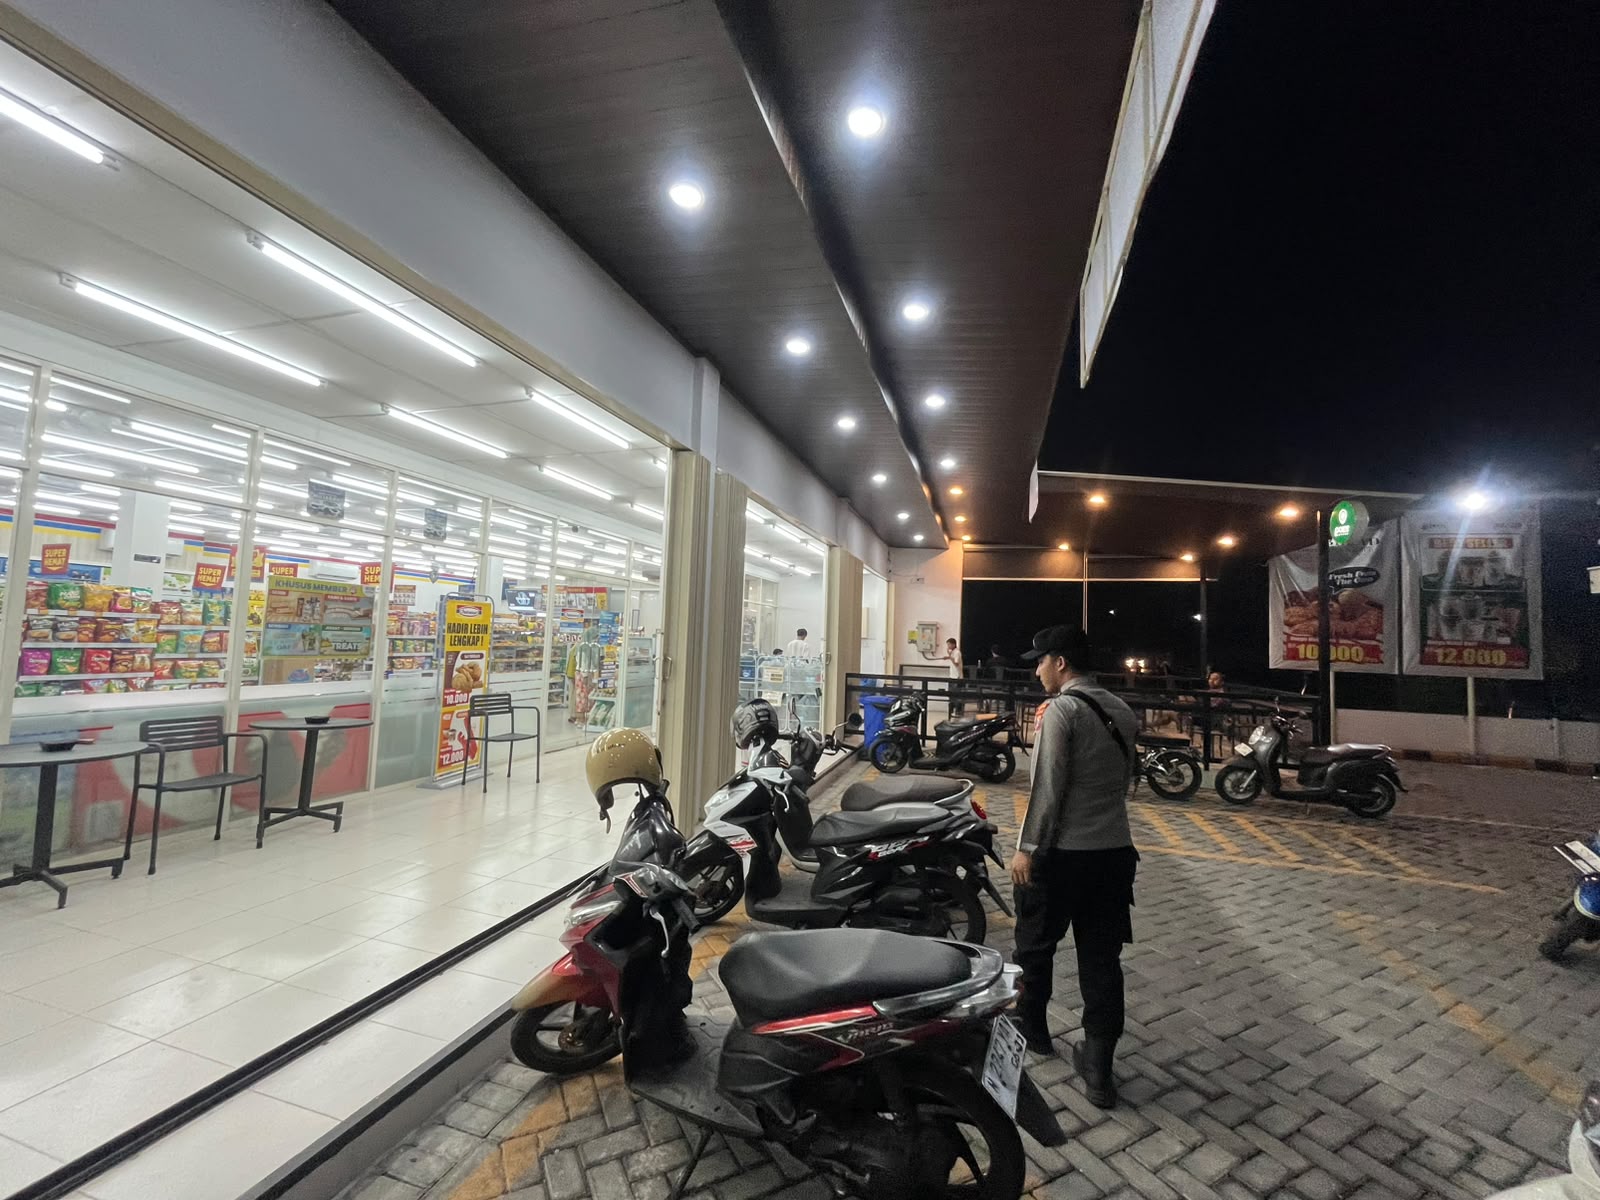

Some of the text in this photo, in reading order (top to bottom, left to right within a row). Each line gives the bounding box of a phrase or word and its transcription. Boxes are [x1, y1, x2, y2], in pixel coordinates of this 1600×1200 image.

[45, 549, 67, 557] SUPER
[44, 558, 66, 567] HEMAT
[199, 566, 222, 577] SUPER
[271, 566, 294, 575] SUPER
[364, 566, 381, 575] SUP
[197, 575, 220, 583] HEMAT
[275, 579, 347, 593] KHUSUS MEMBER
[447, 622, 488, 635] HADIR LEBIH
[450, 635, 480, 646] LENGKAP
